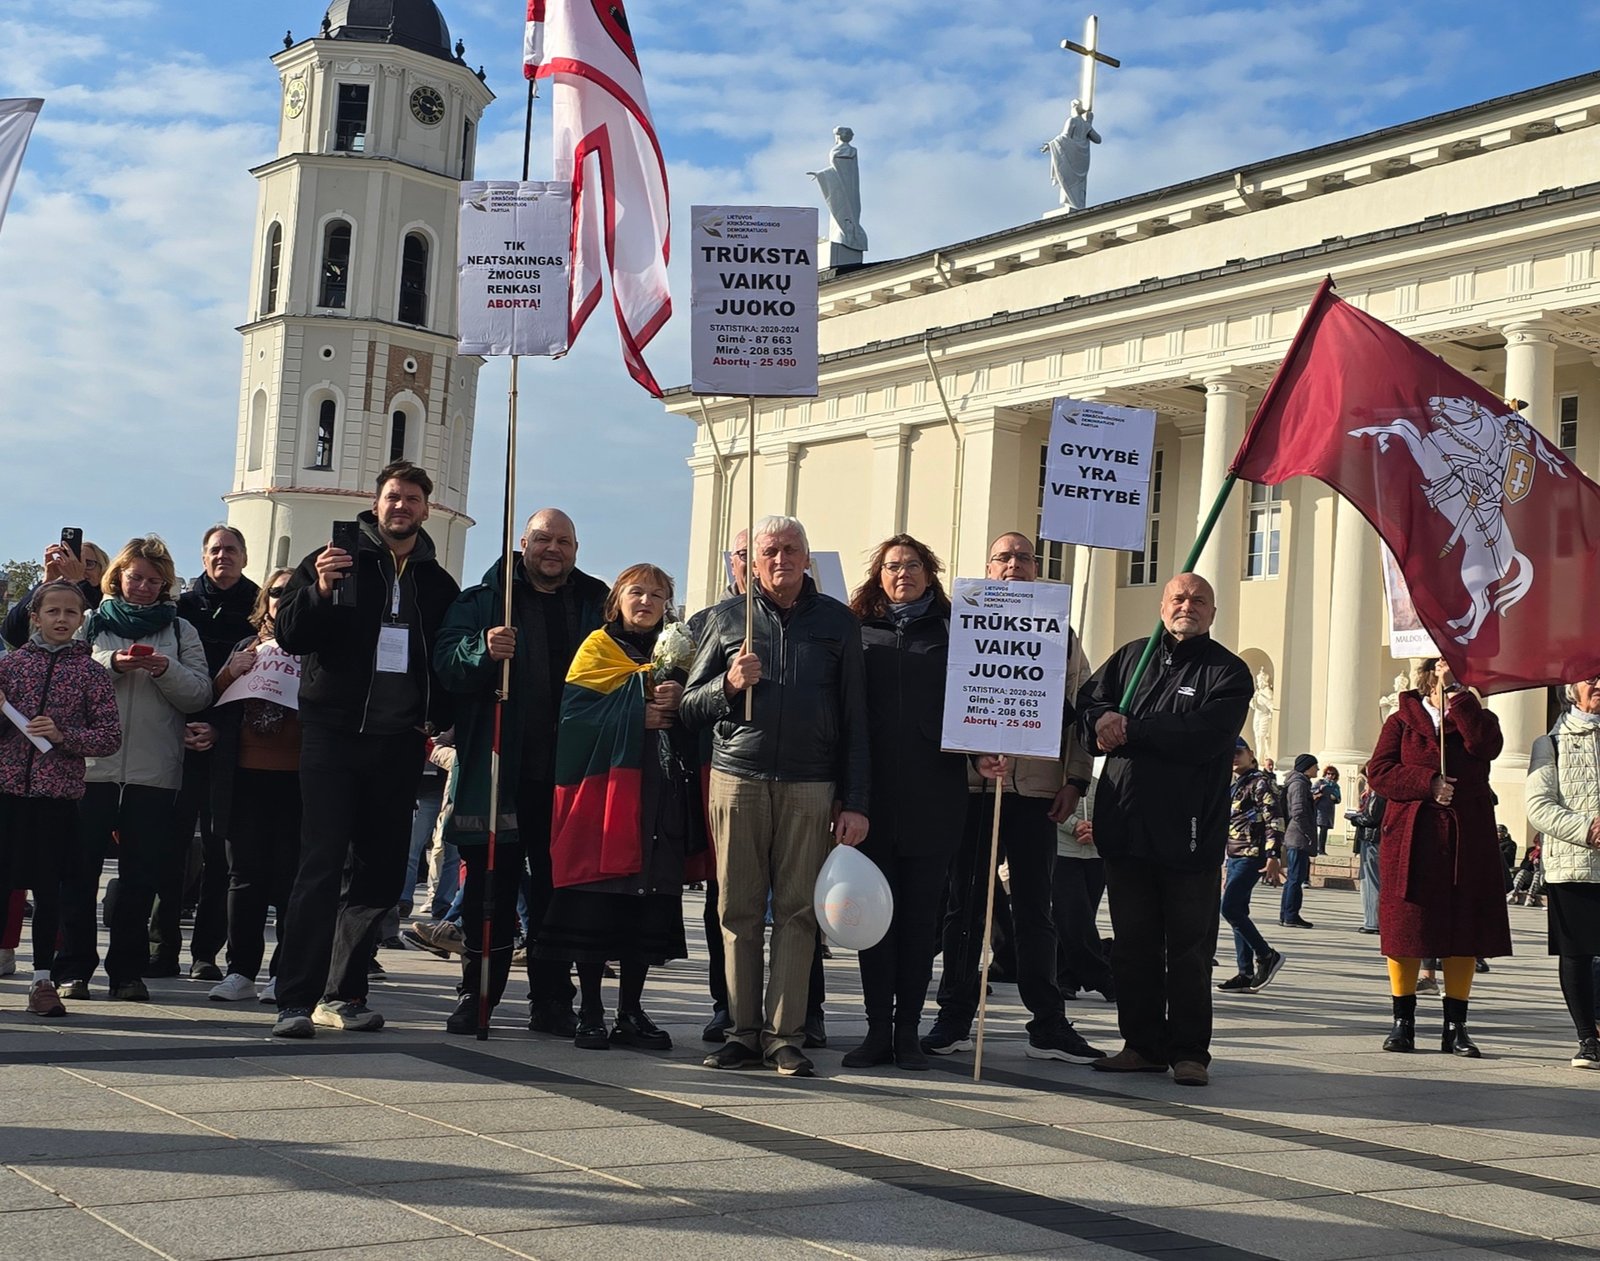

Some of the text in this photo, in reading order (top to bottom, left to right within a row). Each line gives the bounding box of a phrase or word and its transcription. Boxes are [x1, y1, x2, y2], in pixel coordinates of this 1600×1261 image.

[504, 242, 525, 251] TIK
[701, 244, 810, 265] TRŪKSTA
[467, 256, 563, 266] NEATSAKINGAS
[488, 269, 540, 279] ŽMOGUS
[487, 284, 541, 294] RENKASI
[719, 273, 791, 294] VAIKŲ
[487, 299, 541, 310] ABORTĄ!
[715, 299, 796, 316] JUOKO
[718, 334, 746, 344] Gimė
[755, 336, 770, 344] 87
[773, 336, 792, 344] 663
[716, 346, 740, 355] Mirė
[750, 347, 770, 355] 208
[773, 347, 793, 355] 635
[712, 357, 750, 368] Abortų
[760, 358, 773, 366] 25
[776, 359, 797, 367] 490
[1060, 443, 1140, 465] GYVYBĖ
[1078, 465, 1117, 482] YRA
[1051, 483, 1140, 505] VERTYBĖ
[960, 613, 1060, 633] TRŪKSTA
[974, 639, 1042, 660] VAIKŲ
[968, 664, 1044, 681] JUOKO
[963, 686, 1046, 697] STATISTIKA: 2020-2024
[969, 696, 995, 704] Gimė
[1004, 698, 1018, 706] 87
[967, 706, 989, 714] Mirė
[998, 708, 1016, 716] 208
[1020, 709, 1038, 717] 635
[963, 716, 997, 727] Abortų
[1006, 719, 1019, 727] 25
[1022, 720, 1041, 728] 490
